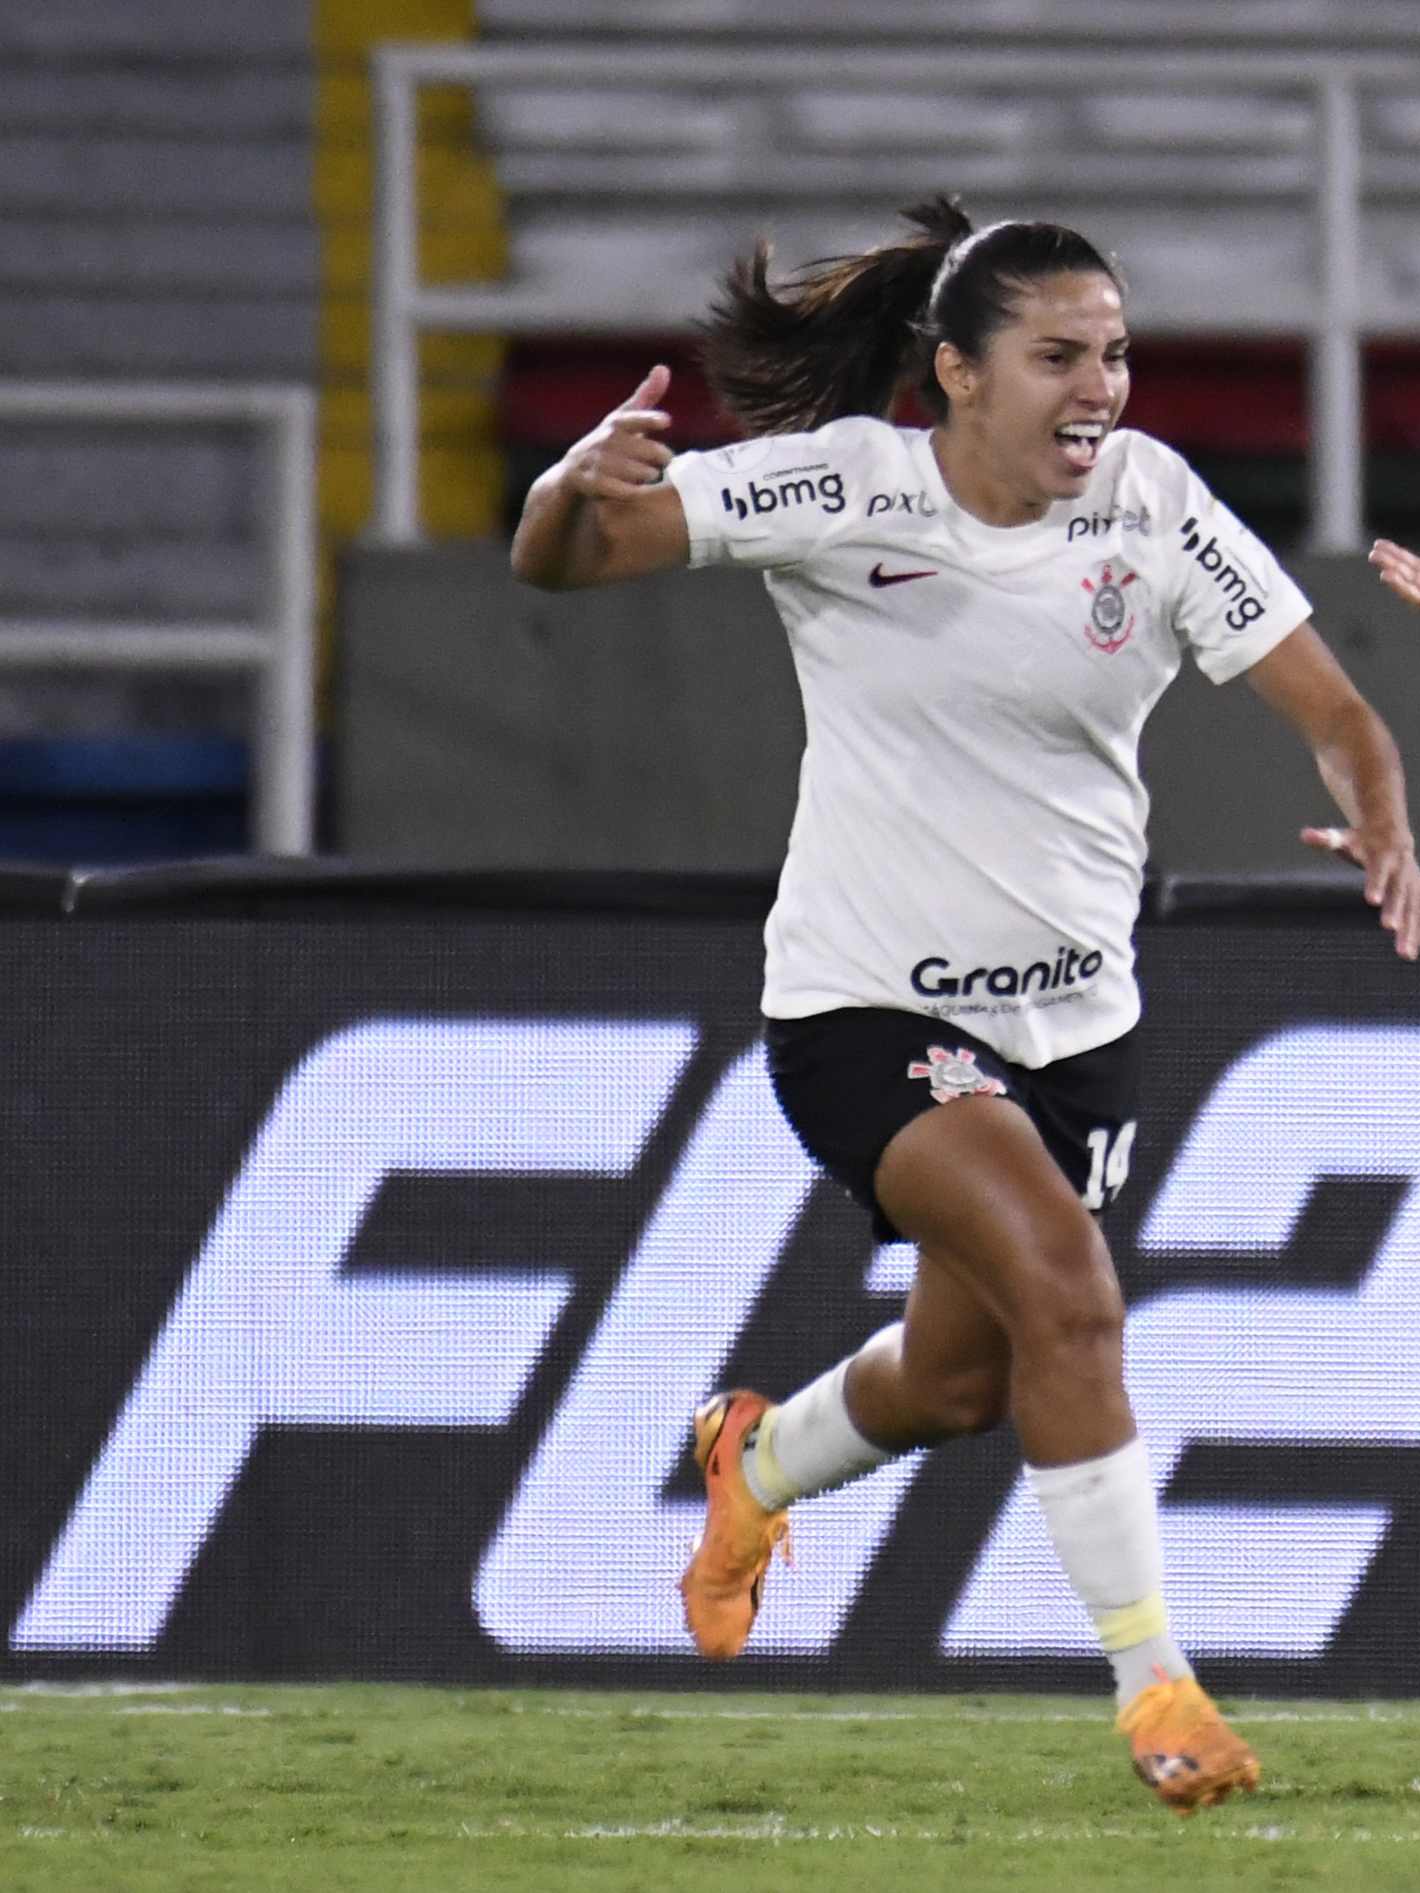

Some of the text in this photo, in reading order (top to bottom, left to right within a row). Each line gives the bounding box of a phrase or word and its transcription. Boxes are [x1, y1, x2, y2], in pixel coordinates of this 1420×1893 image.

[748, 473, 846, 514] bmg
[1195, 536, 1265, 631] bmg
[910, 946, 1103, 998] Granito
[1080, 1121, 1138, 1210] 14
